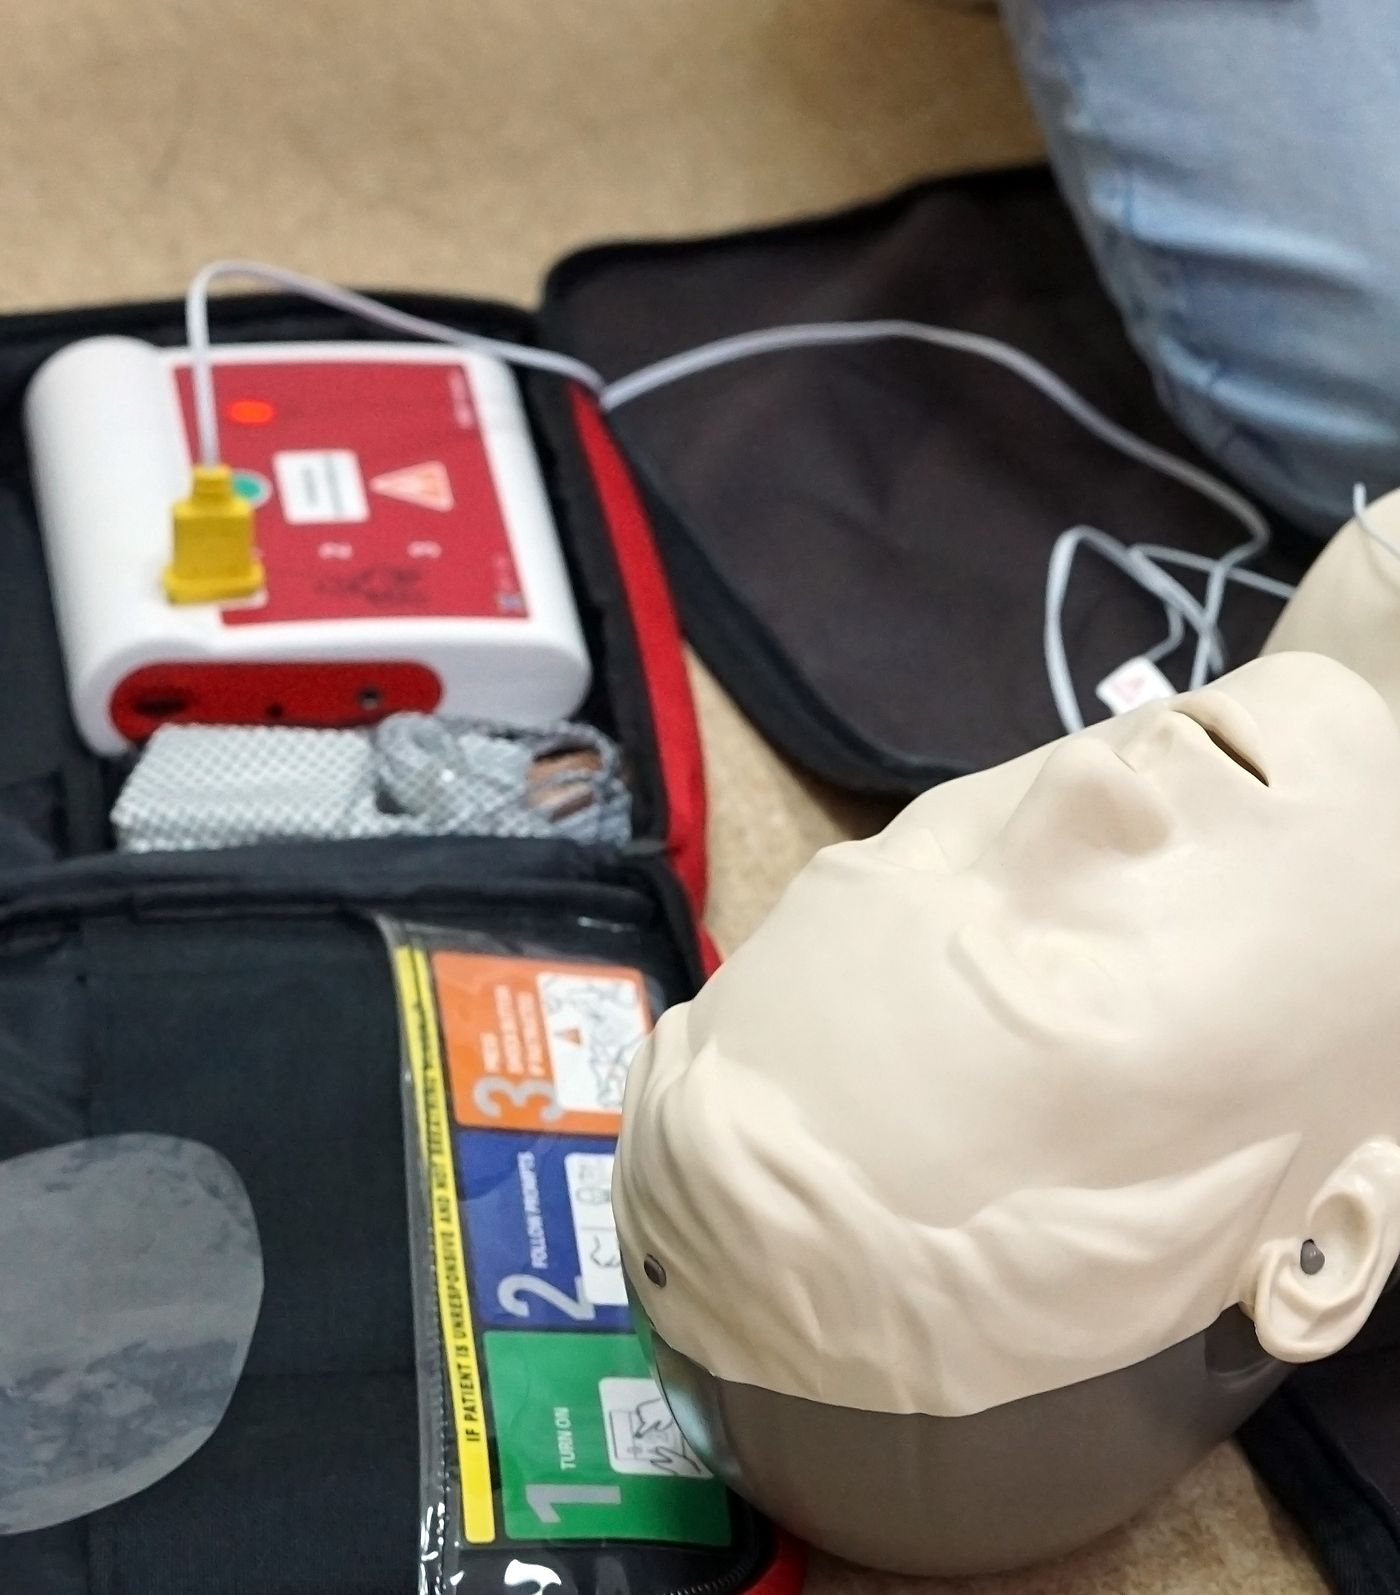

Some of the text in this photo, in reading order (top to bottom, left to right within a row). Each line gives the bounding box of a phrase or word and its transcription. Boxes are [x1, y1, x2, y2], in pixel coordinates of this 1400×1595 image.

[472, 1076, 565, 1122] 3
[436, 1194, 452, 1223] AND
[516, 1151, 550, 1269] FOLLOW PROMPTS
[440, 1231, 467, 1339] UNRESPONSIVE
[497, 1274, 596, 1321] 2
[454, 1344, 470, 1358] IS
[457, 1362, 479, 1422] PATIENT
[465, 1428, 481, 1442] IF
[553, 1406, 577, 1472] TURN ON
[524, 1483, 622, 1524] 1
